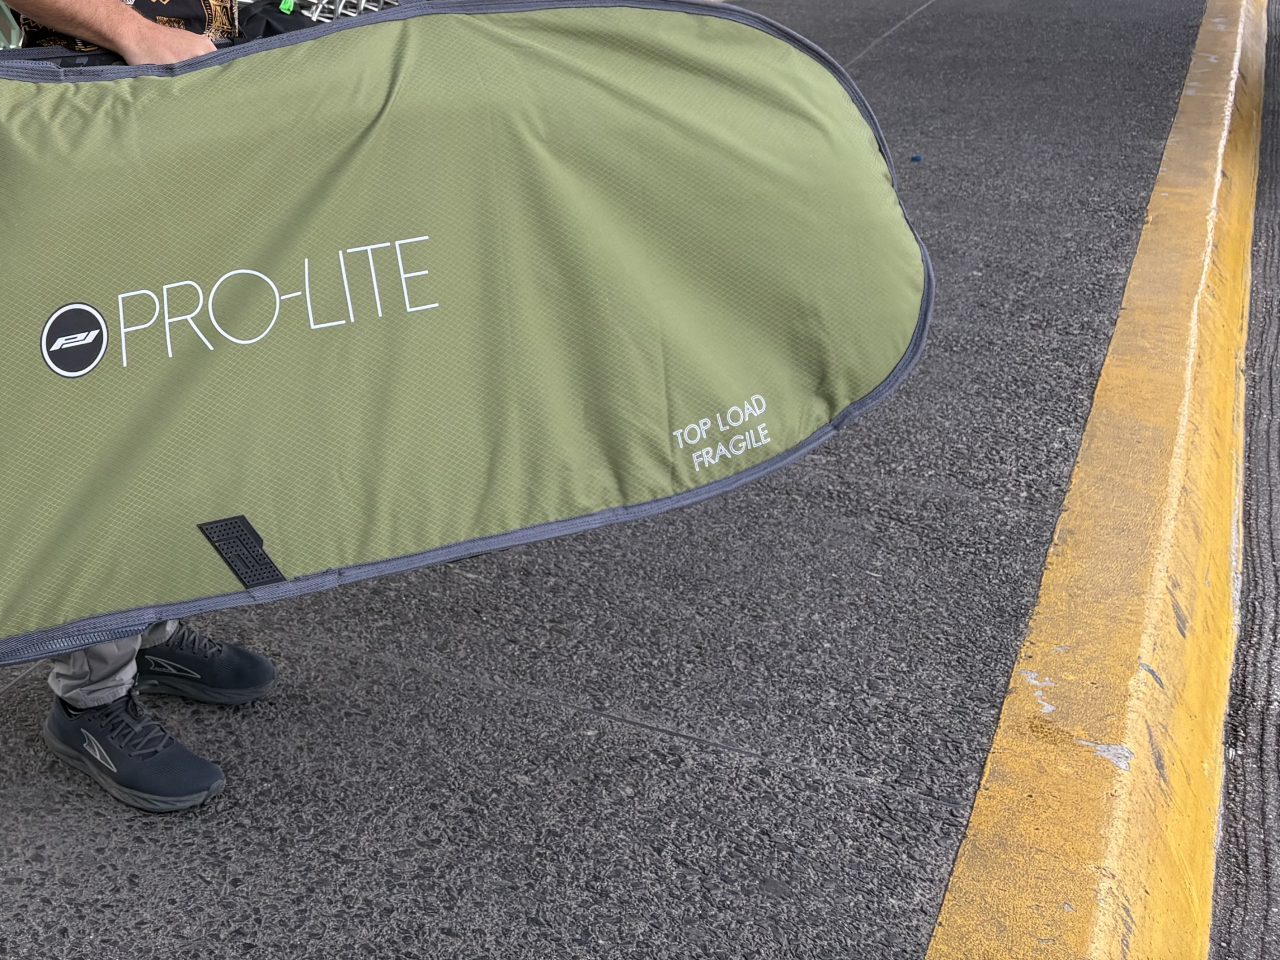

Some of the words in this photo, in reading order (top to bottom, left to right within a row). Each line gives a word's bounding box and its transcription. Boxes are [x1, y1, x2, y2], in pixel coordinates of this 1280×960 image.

[118, 235, 440, 368] PRO-LITE
[672, 418, 711, 448] TOP
[716, 394, 766, 432] LOAD
[692, 423, 771, 471] FRAGILE
